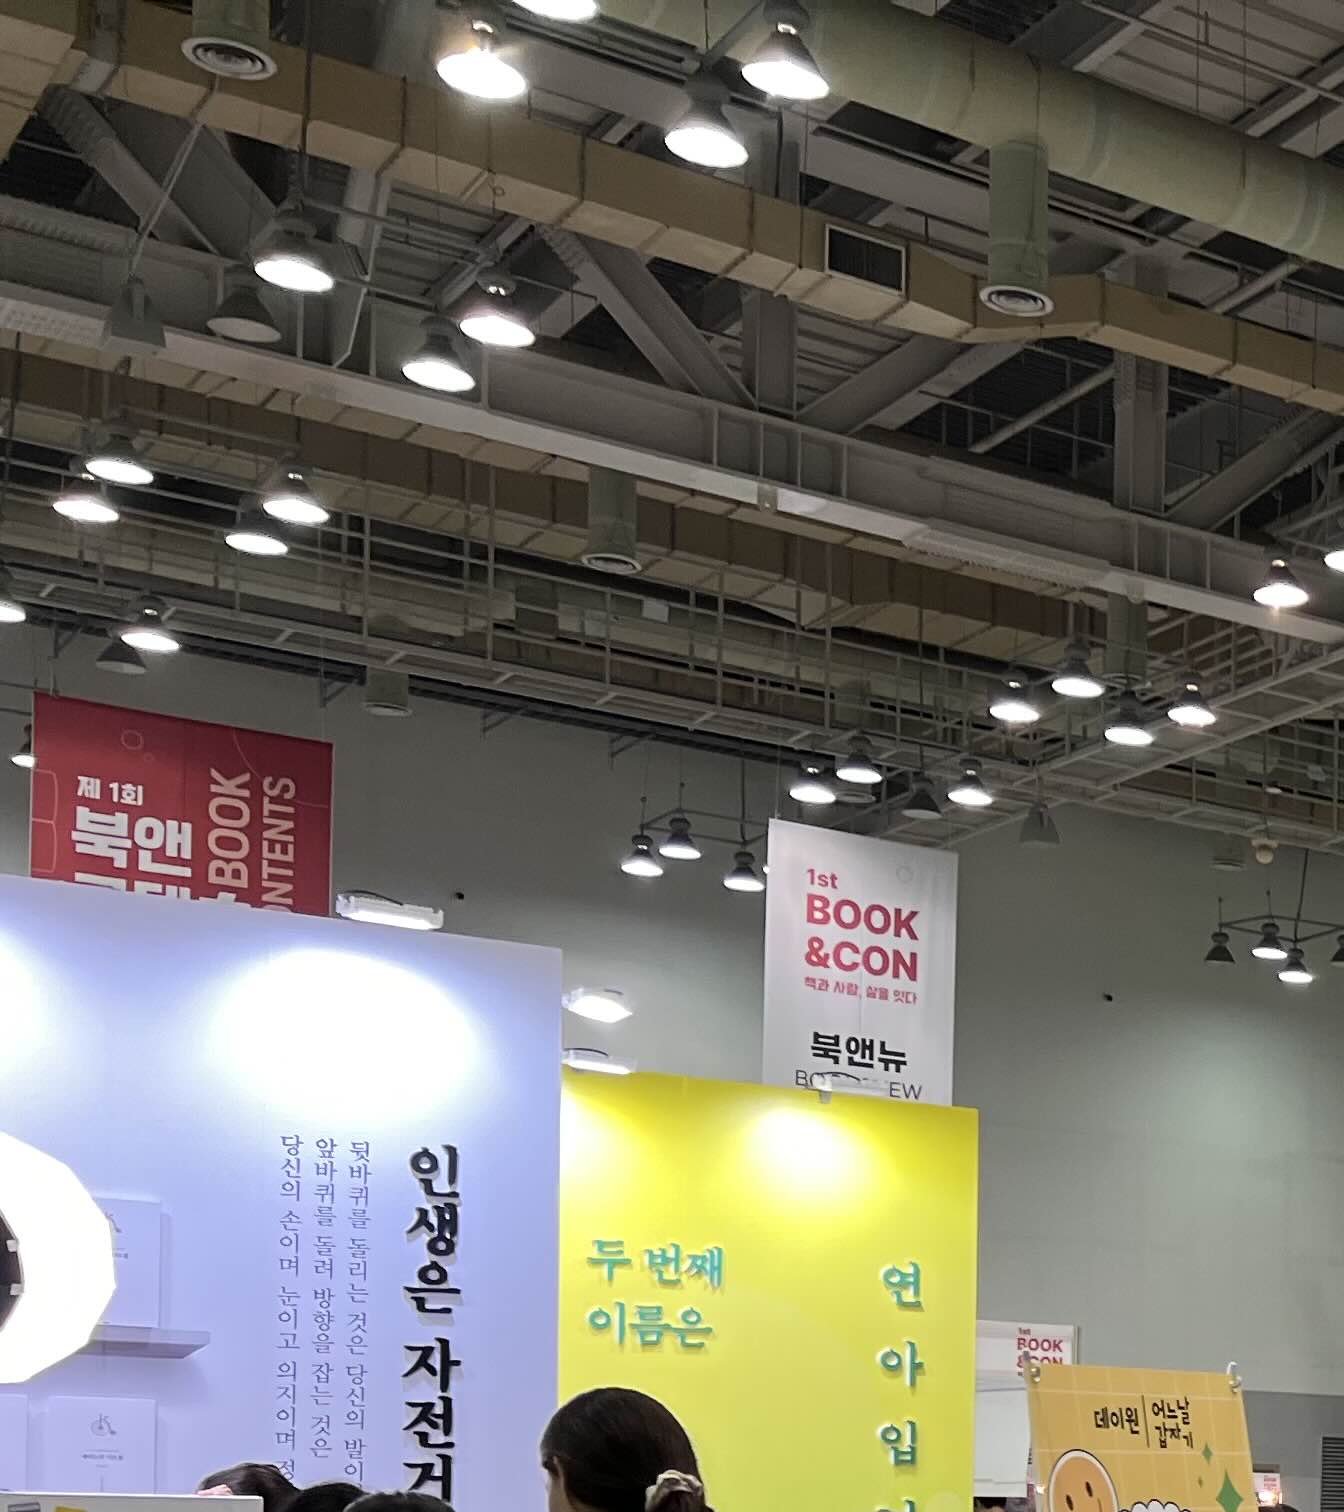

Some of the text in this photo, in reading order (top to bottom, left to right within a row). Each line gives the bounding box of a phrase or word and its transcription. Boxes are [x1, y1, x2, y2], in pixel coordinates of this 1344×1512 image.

[77, 775, 144, 806] 제 1회
[71, 805, 192, 878] 북앤
[207, 767, 250, 889] BOOK
[807, 868, 838, 889] 1st
[806, 893, 919, 940] BOOK
[804, 936, 918, 982] &CON
[810, 1031, 907, 1074] 북앤뉴
[279, 1134, 304, 1202] 당신의
[278, 1209, 303, 1277] 손이며
[587, 1239, 725, 1290] 두 번째
[277, 1286, 301, 1350] 눈이고
[308, 1137, 338, 1459] 앞바퀴를 돌려 방향을 잡는 것은
[343, 1140, 373, 1490] 뒷바퀴를 돌리는 것은 당신의 발이
[401, 1143, 463, 1500] 인생은 자전거
[586, 1301, 714, 1348] 이름은
[1017, 1337, 1063, 1352] BOOK
[275, 1360, 297, 1451] 의지이며
[1093, 1406, 1140, 1435] 데이원
[1151, 1396, 1191, 1425] 어느날
[1154, 1423, 1194, 1448] 갑자기
